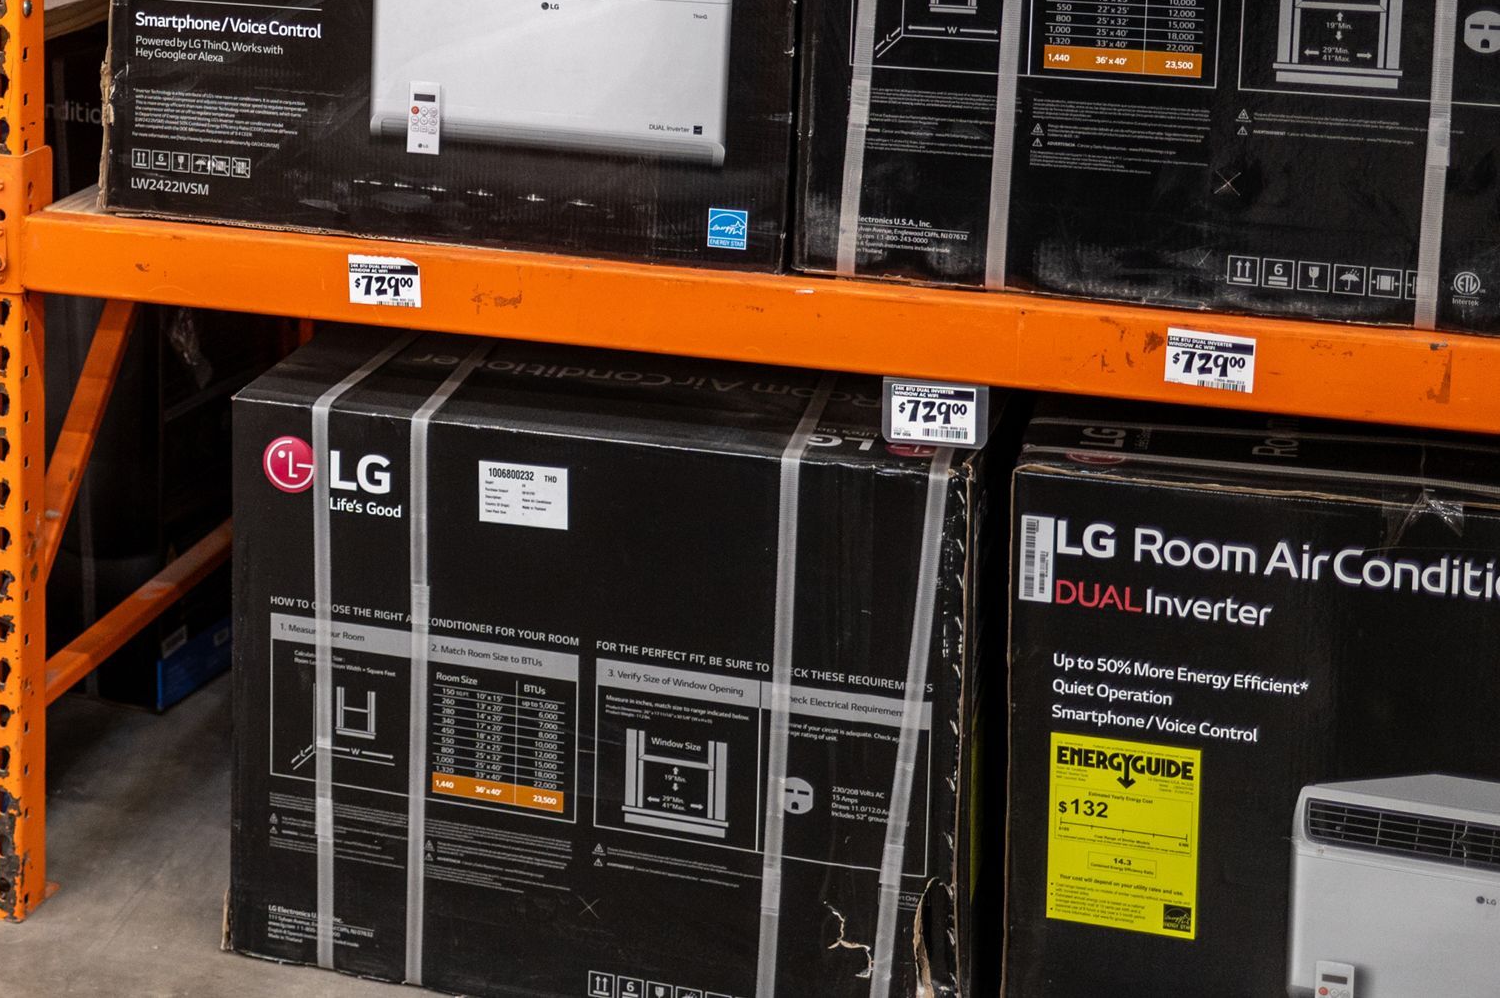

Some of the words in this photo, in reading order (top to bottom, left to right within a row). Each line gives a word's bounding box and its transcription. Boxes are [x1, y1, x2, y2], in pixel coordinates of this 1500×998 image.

[132, 177, 209, 196] LW2422IVSM
[329, 451, 391, 494] LG
[329, 496, 362, 514] Life's
[366, 501, 401, 518] Good
[1056, 519, 1116, 558] LG
[1134, 527, 1256, 574] Room
[1263, 541, 1330, 580] Air
[1334, 547, 1500, 600] Conditi
[1055, 579, 1142, 613] DUAL
[1146, 588, 1272, 627] Inverter
[1052, 679, 1094, 696] Quiet
[1096, 684, 1172, 705] Operation
[1052, 705, 1144, 728] Smartphone
[1156, 717, 1196, 734] Voice
[1199, 723, 1258, 742] Control
[1114, 858, 1132, 866] 14.3
